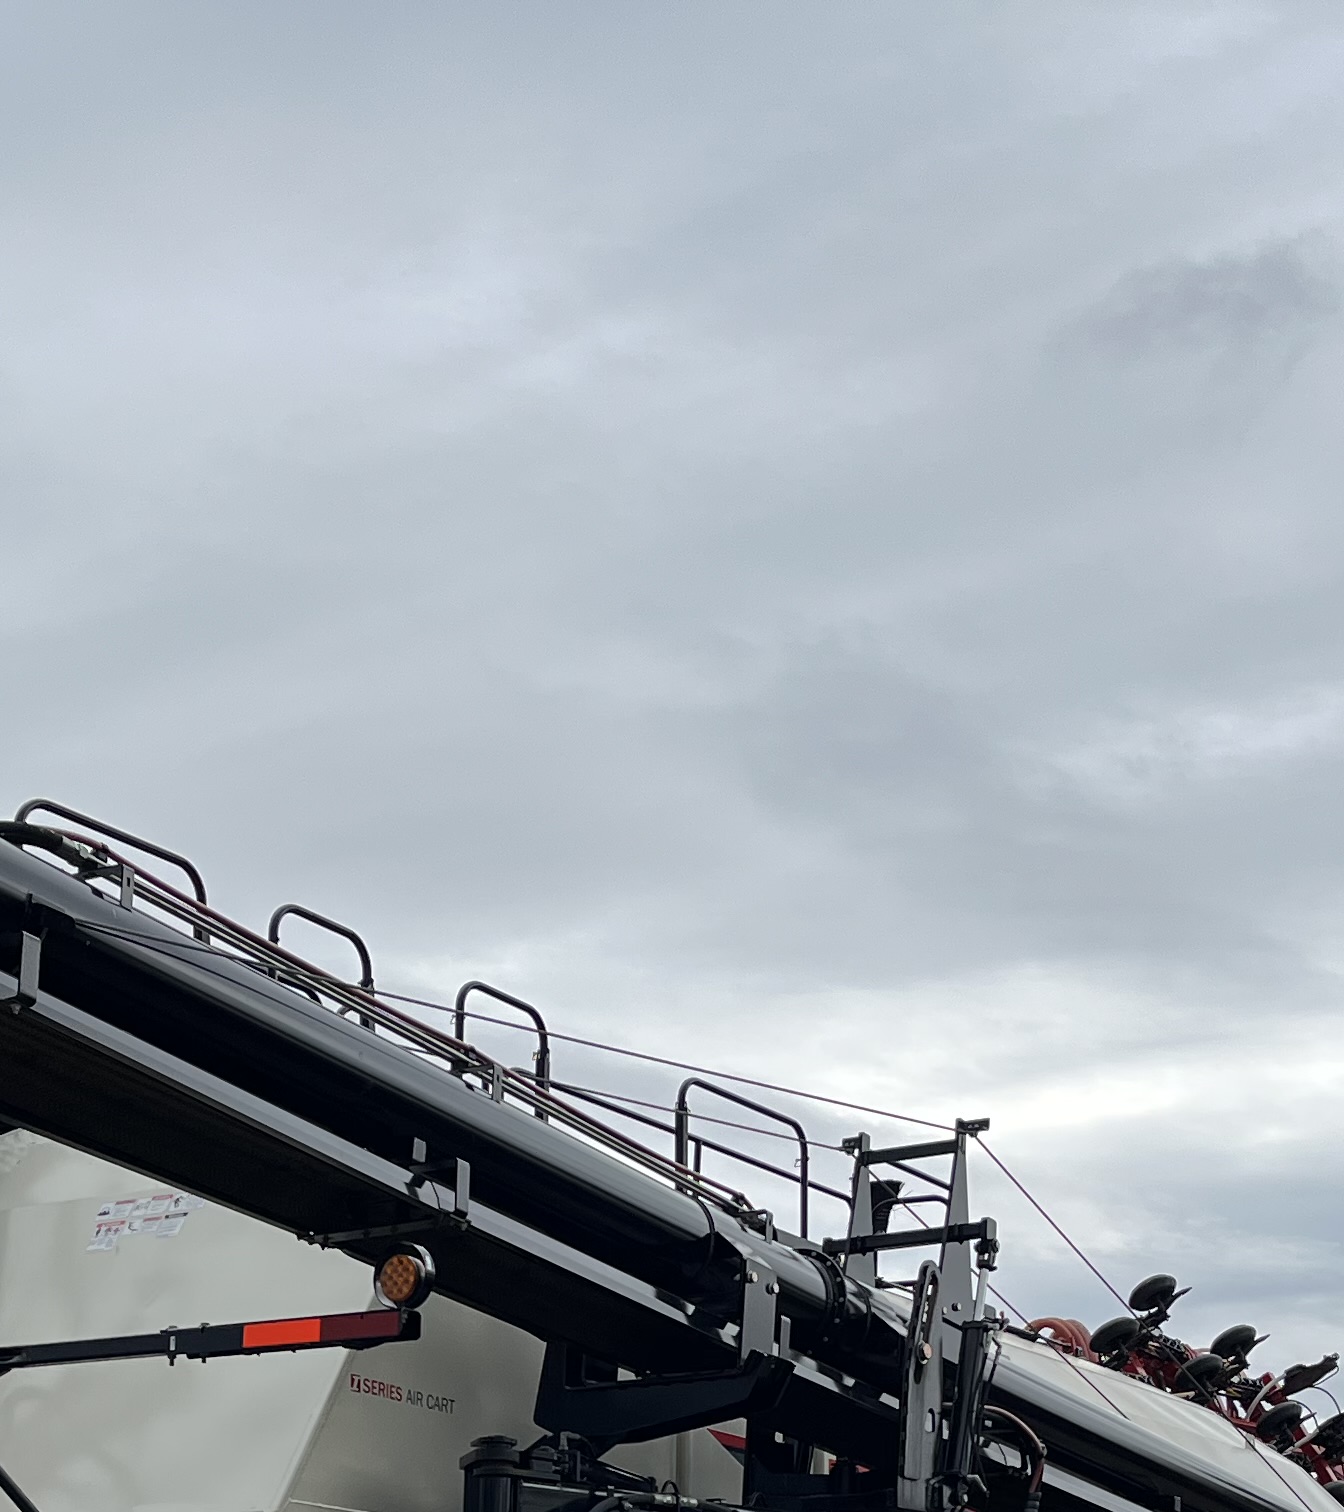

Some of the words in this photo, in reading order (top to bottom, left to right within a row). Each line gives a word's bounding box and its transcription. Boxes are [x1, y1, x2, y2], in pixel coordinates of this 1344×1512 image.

[362, 1378, 403, 1402] SERIES
[406, 1389, 424, 1408] AIR
[426, 1394, 456, 1414] CART
